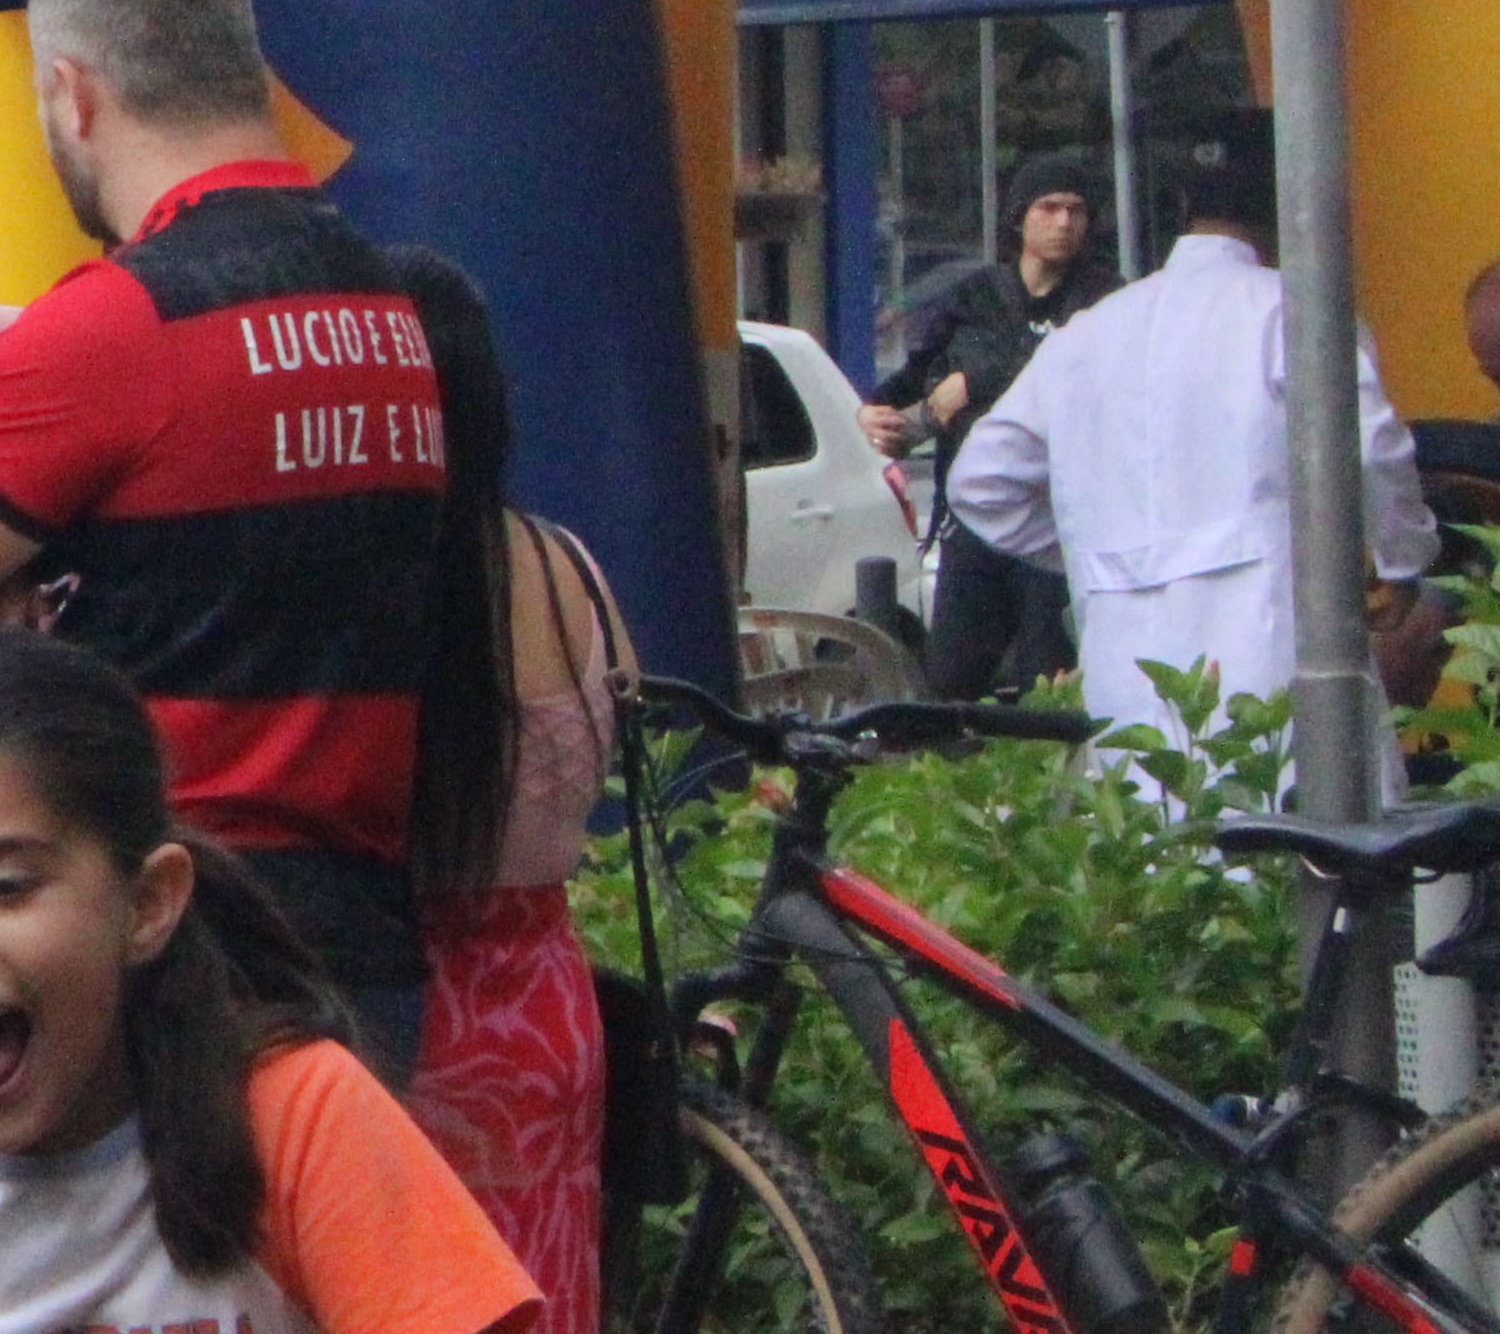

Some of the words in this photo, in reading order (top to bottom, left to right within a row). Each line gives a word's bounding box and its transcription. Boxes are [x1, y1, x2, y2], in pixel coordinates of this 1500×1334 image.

[240, 307, 364, 375] LUCIO
[364, 309, 389, 365] E
[275, 404, 368, 473] LUIZ
[386, 404, 403, 463] E
